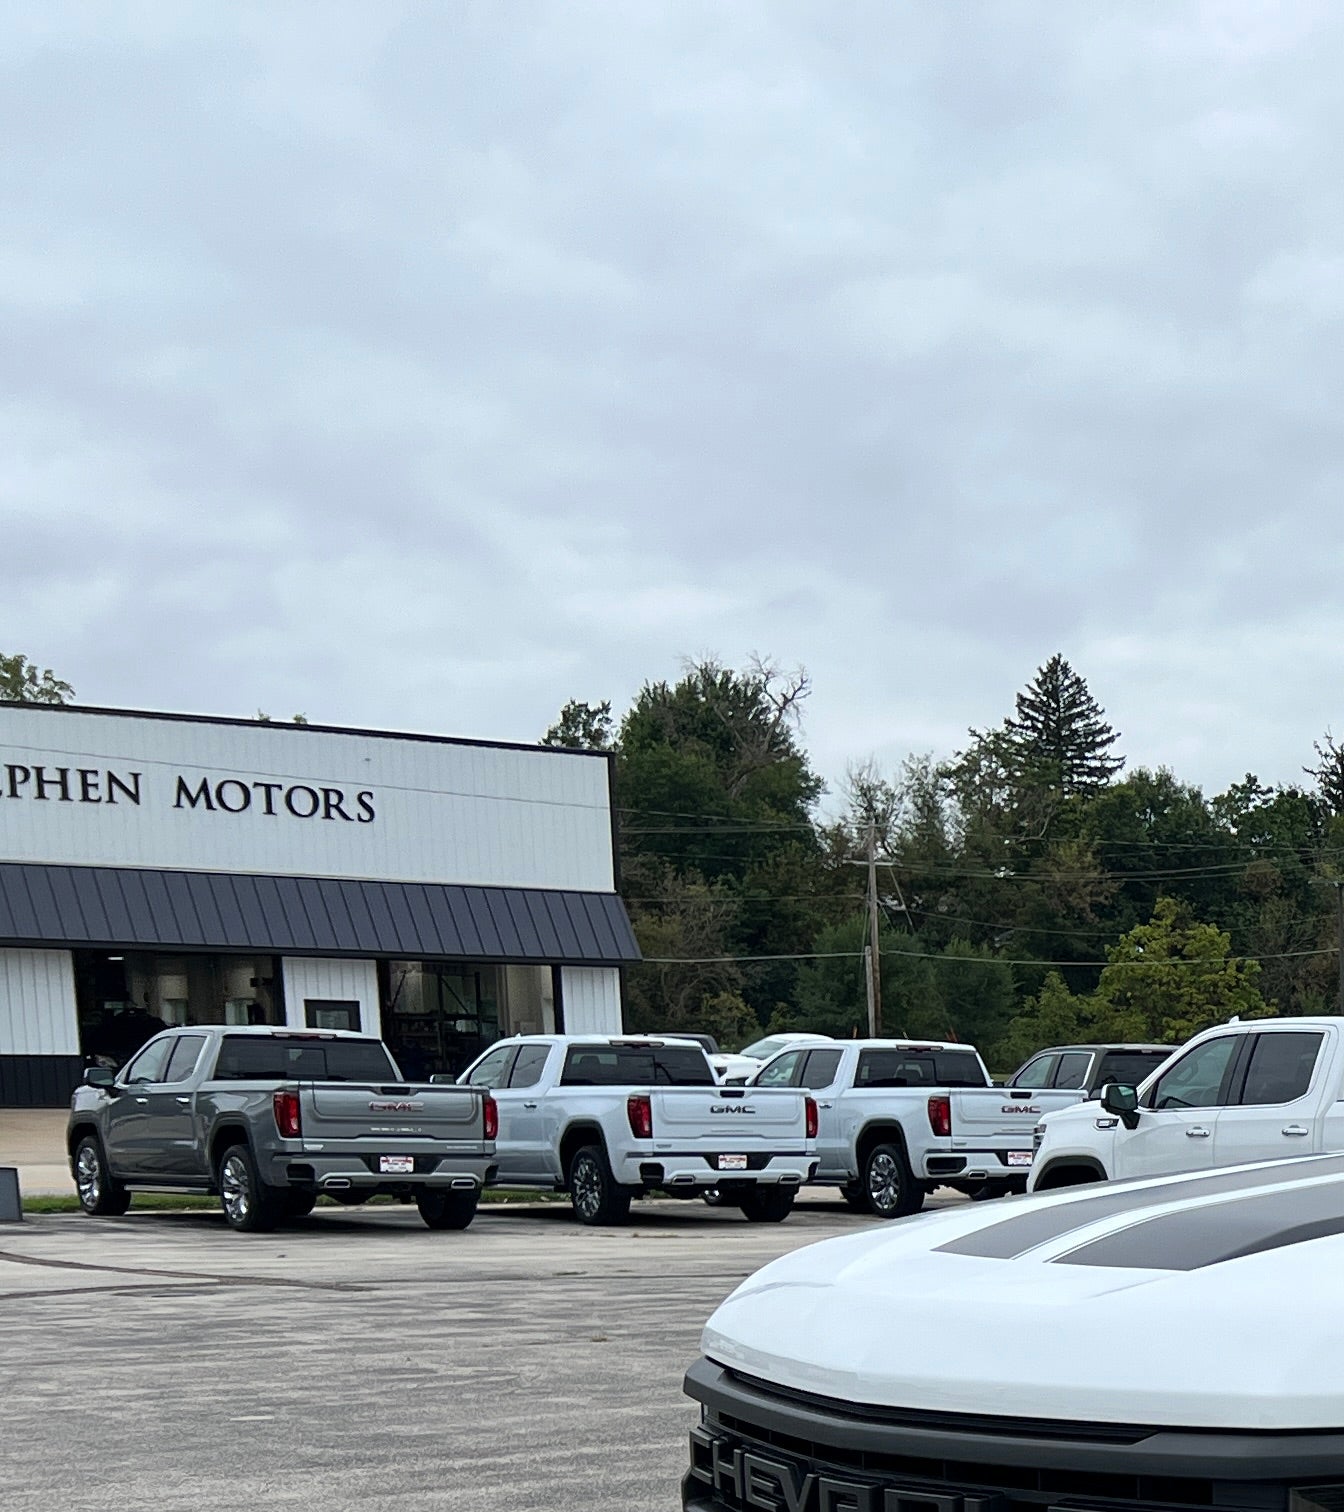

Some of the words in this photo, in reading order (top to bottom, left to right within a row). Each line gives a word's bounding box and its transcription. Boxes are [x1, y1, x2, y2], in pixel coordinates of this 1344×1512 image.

[0, 763, 142, 805] PHEN
[173, 774, 375, 823] MOTORS
[710, 1105, 756, 1114] GMC
[1001, 1105, 1041, 1114] GMC
